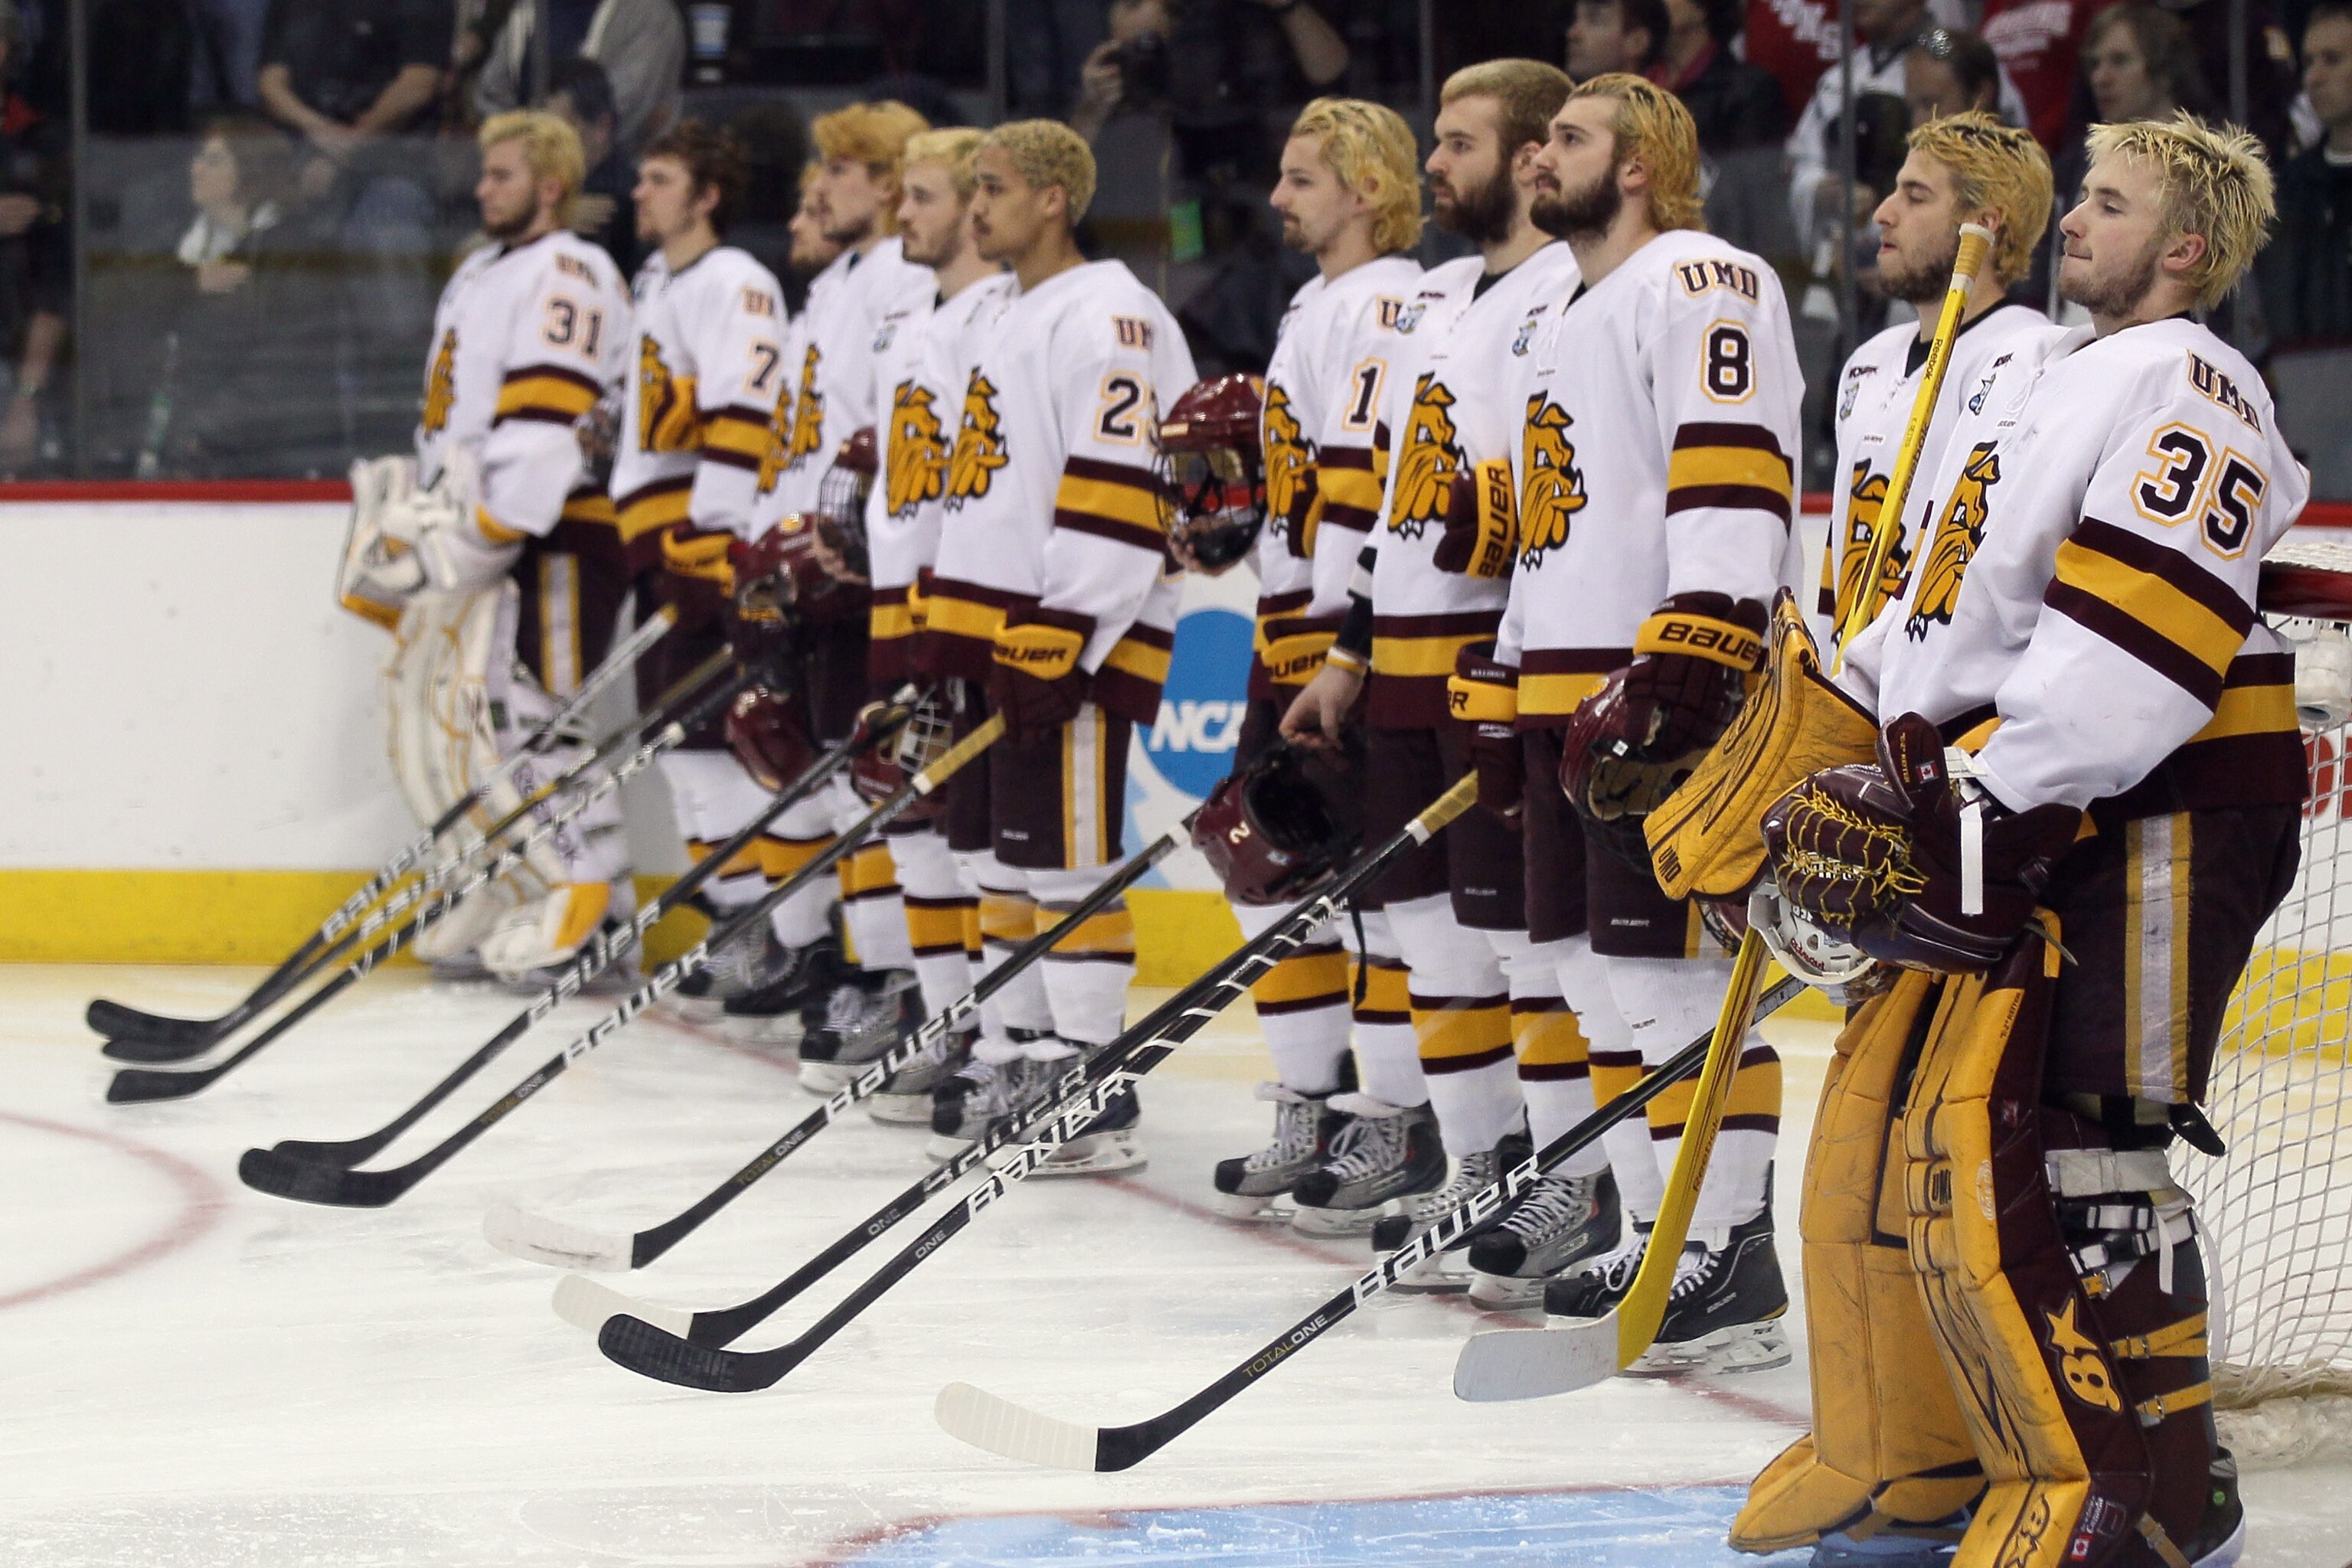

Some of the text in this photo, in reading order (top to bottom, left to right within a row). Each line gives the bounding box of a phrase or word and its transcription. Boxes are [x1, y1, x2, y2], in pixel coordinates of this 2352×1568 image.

[1677, 260, 1758, 302] UMD
[544, 296, 605, 360] 31
[1704, 322, 1753, 400] 8
[1924, 338, 1943, 381] Reebok
[750, 341, 782, 391] 7
[1345, 360, 1383, 428] 1
[2189, 351, 2263, 437] UMD
[1096, 372, 1153, 446] 2
[1478, 465, 1509, 577] BAUER
[2132, 425, 2266, 557] 35
[1658, 844, 1682, 884] UMD
[825, 991, 979, 1122] BAUER
[1693, 1116, 1718, 1192] Reebok
[867, 1208, 901, 1236] ONE
[915, 1230, 946, 1259] ONE
[1352, 1154, 1541, 1308] BAUER
